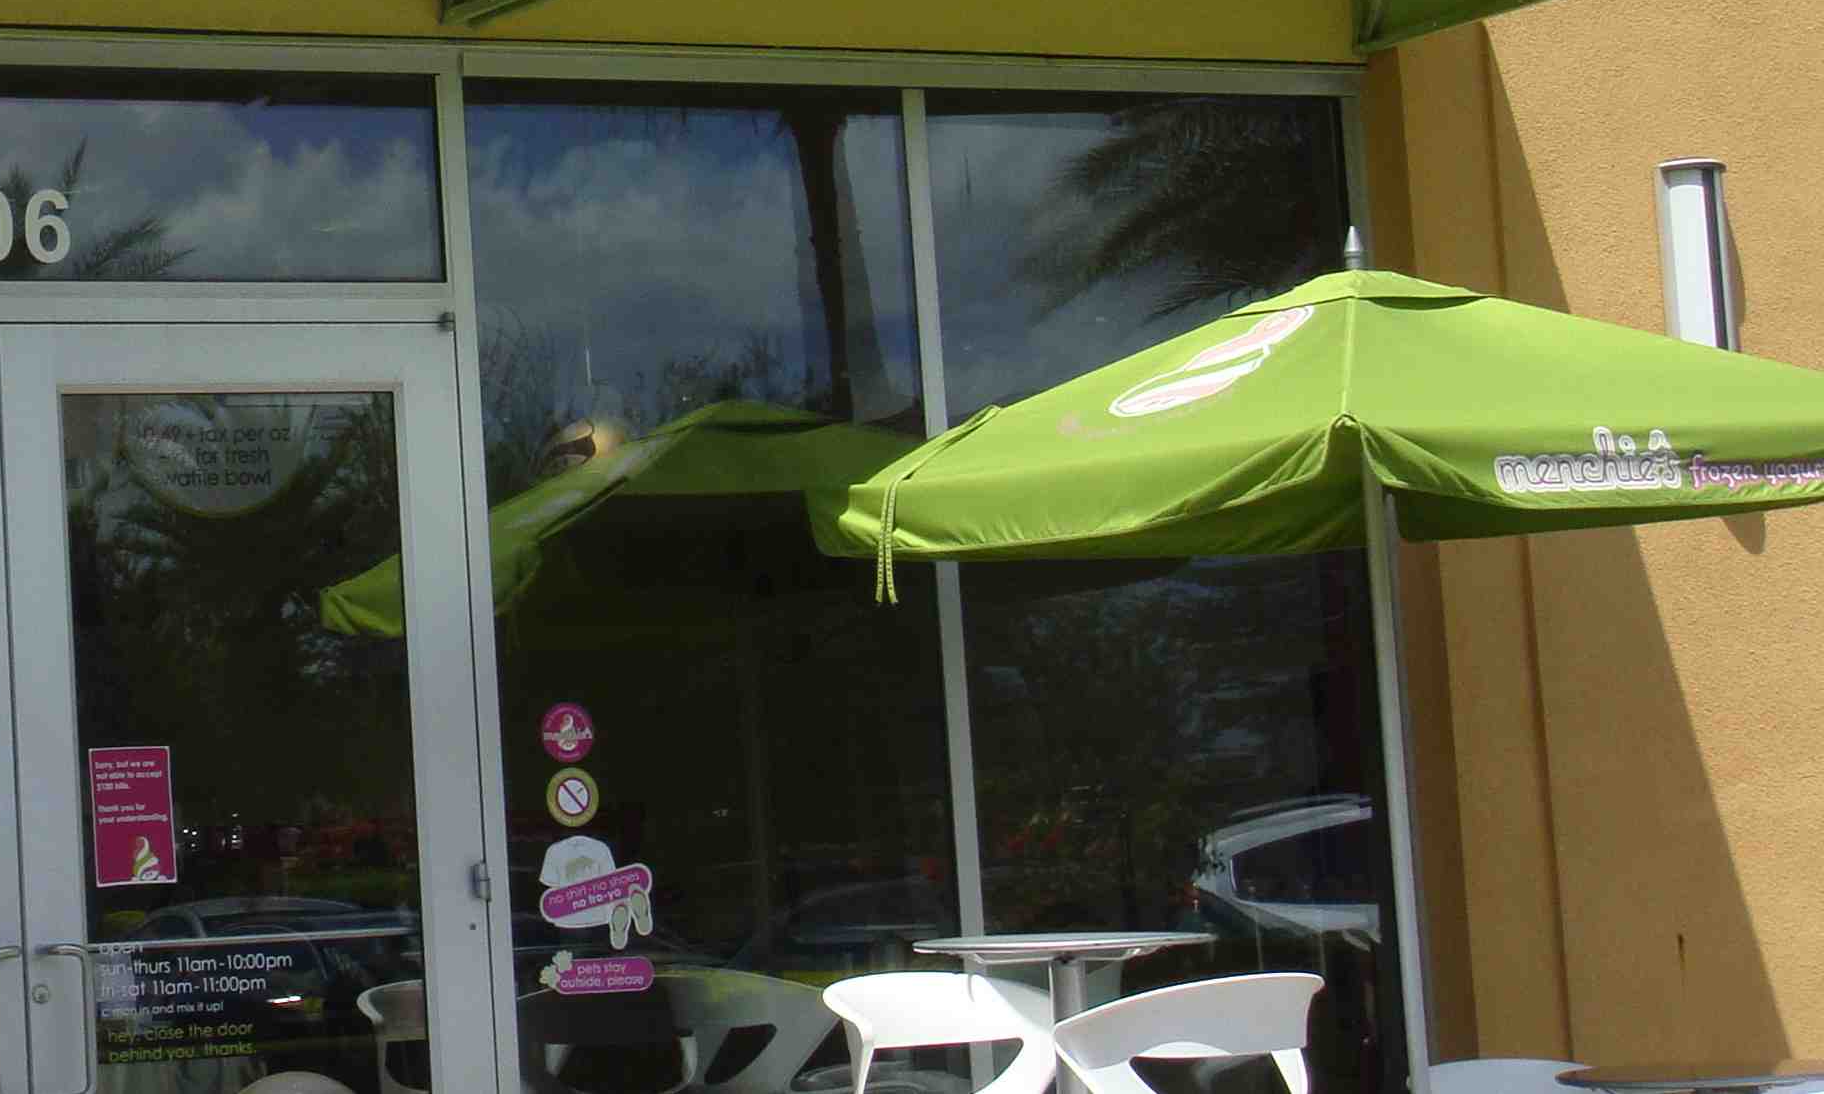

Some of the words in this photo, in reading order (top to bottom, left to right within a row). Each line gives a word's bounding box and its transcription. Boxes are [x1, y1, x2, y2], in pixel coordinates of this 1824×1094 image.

[232, 425, 265, 444] per
[226, 446, 270, 465] fresh
[1494, 426, 1682, 493] menchie's
[1688, 454, 1760, 489] frozen
[1762, 462, 1824, 486] yogur
[223, 469, 272, 487] bowl
[151, 1002, 175, 1015] and
[176, 1002, 195, 1014] mix
[188, 1023, 214, 1038] the
[217, 1021, 254, 1036] door
[109, 1047, 163, 1064] behind
